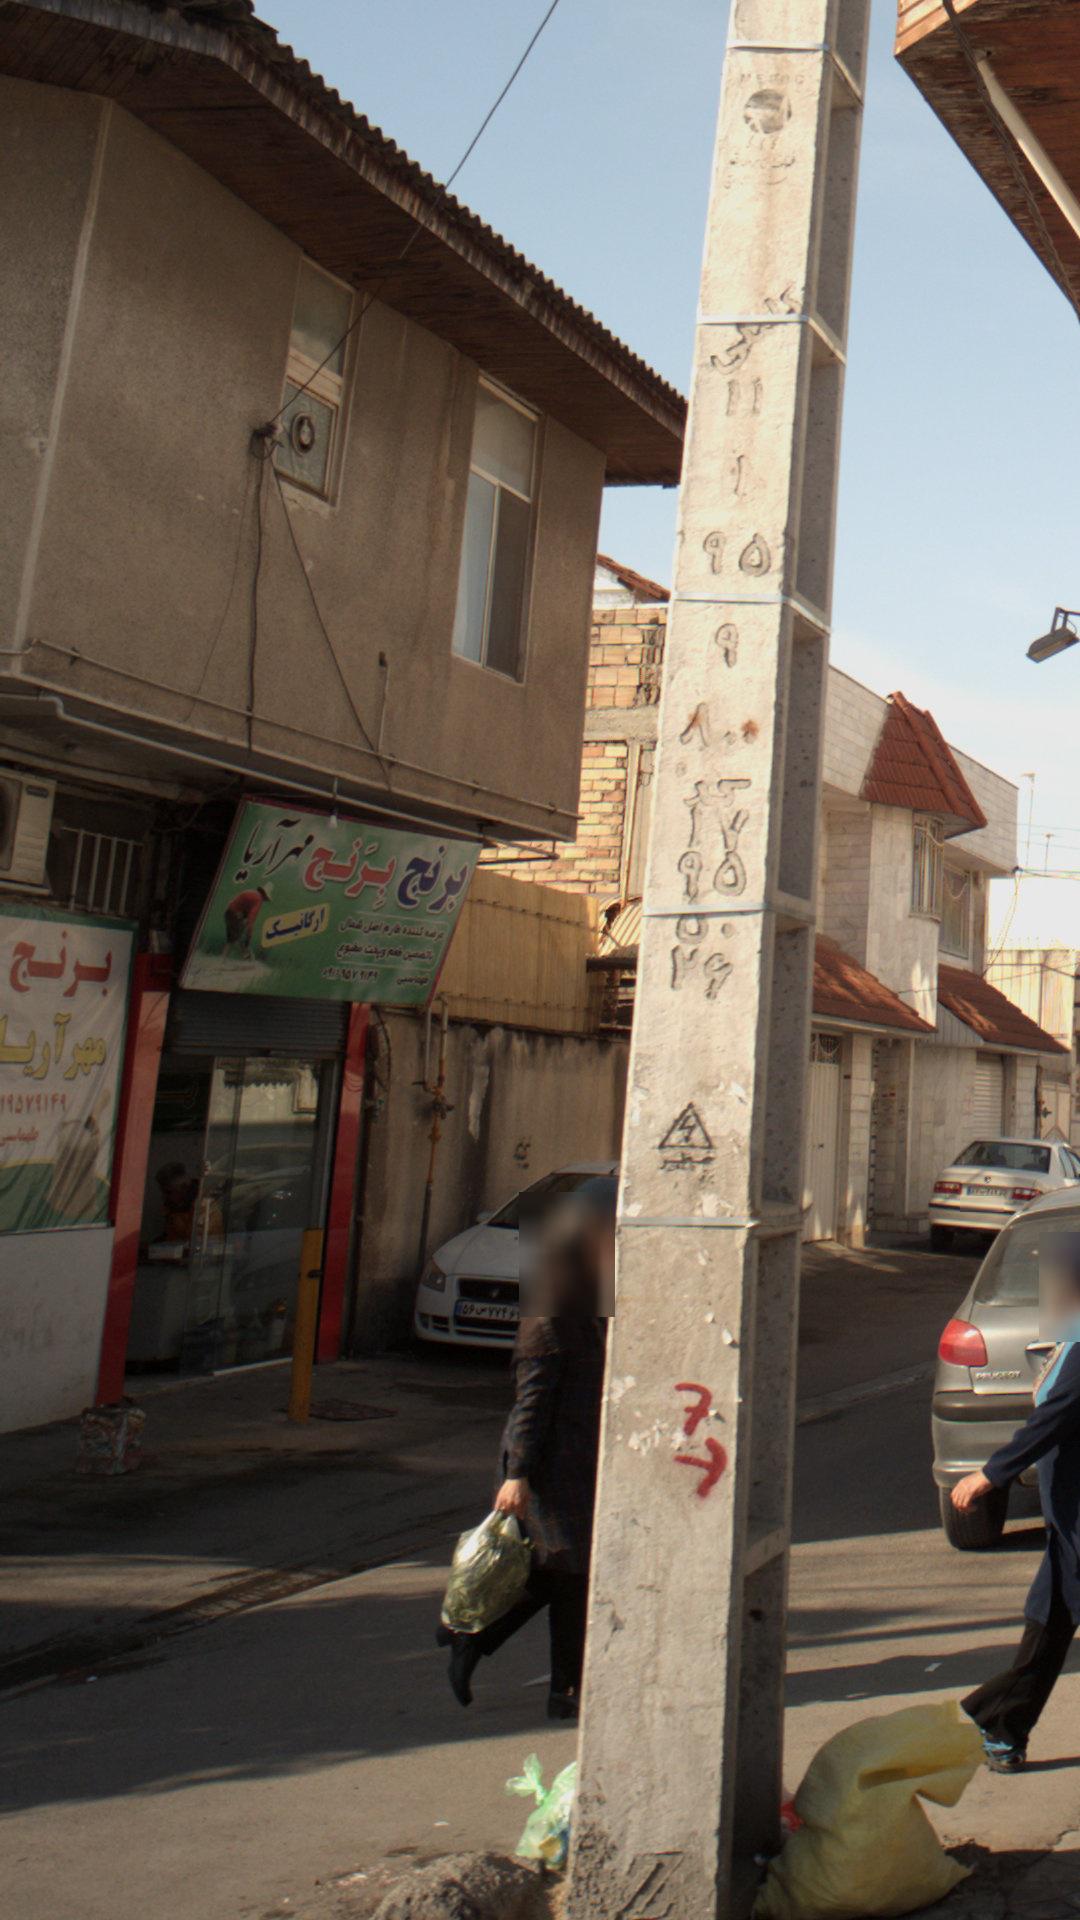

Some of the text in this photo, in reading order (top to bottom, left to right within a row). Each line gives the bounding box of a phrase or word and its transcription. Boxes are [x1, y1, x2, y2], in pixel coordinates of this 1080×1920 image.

[703, 531, 771, 577] ۹۵
[398, 844, 468, 913] برنج
[266, 906, 326, 940] ارگانیک
[9, 930, 112, 998] برنج
[0, 1011, 107, 1081] مهر آریا
